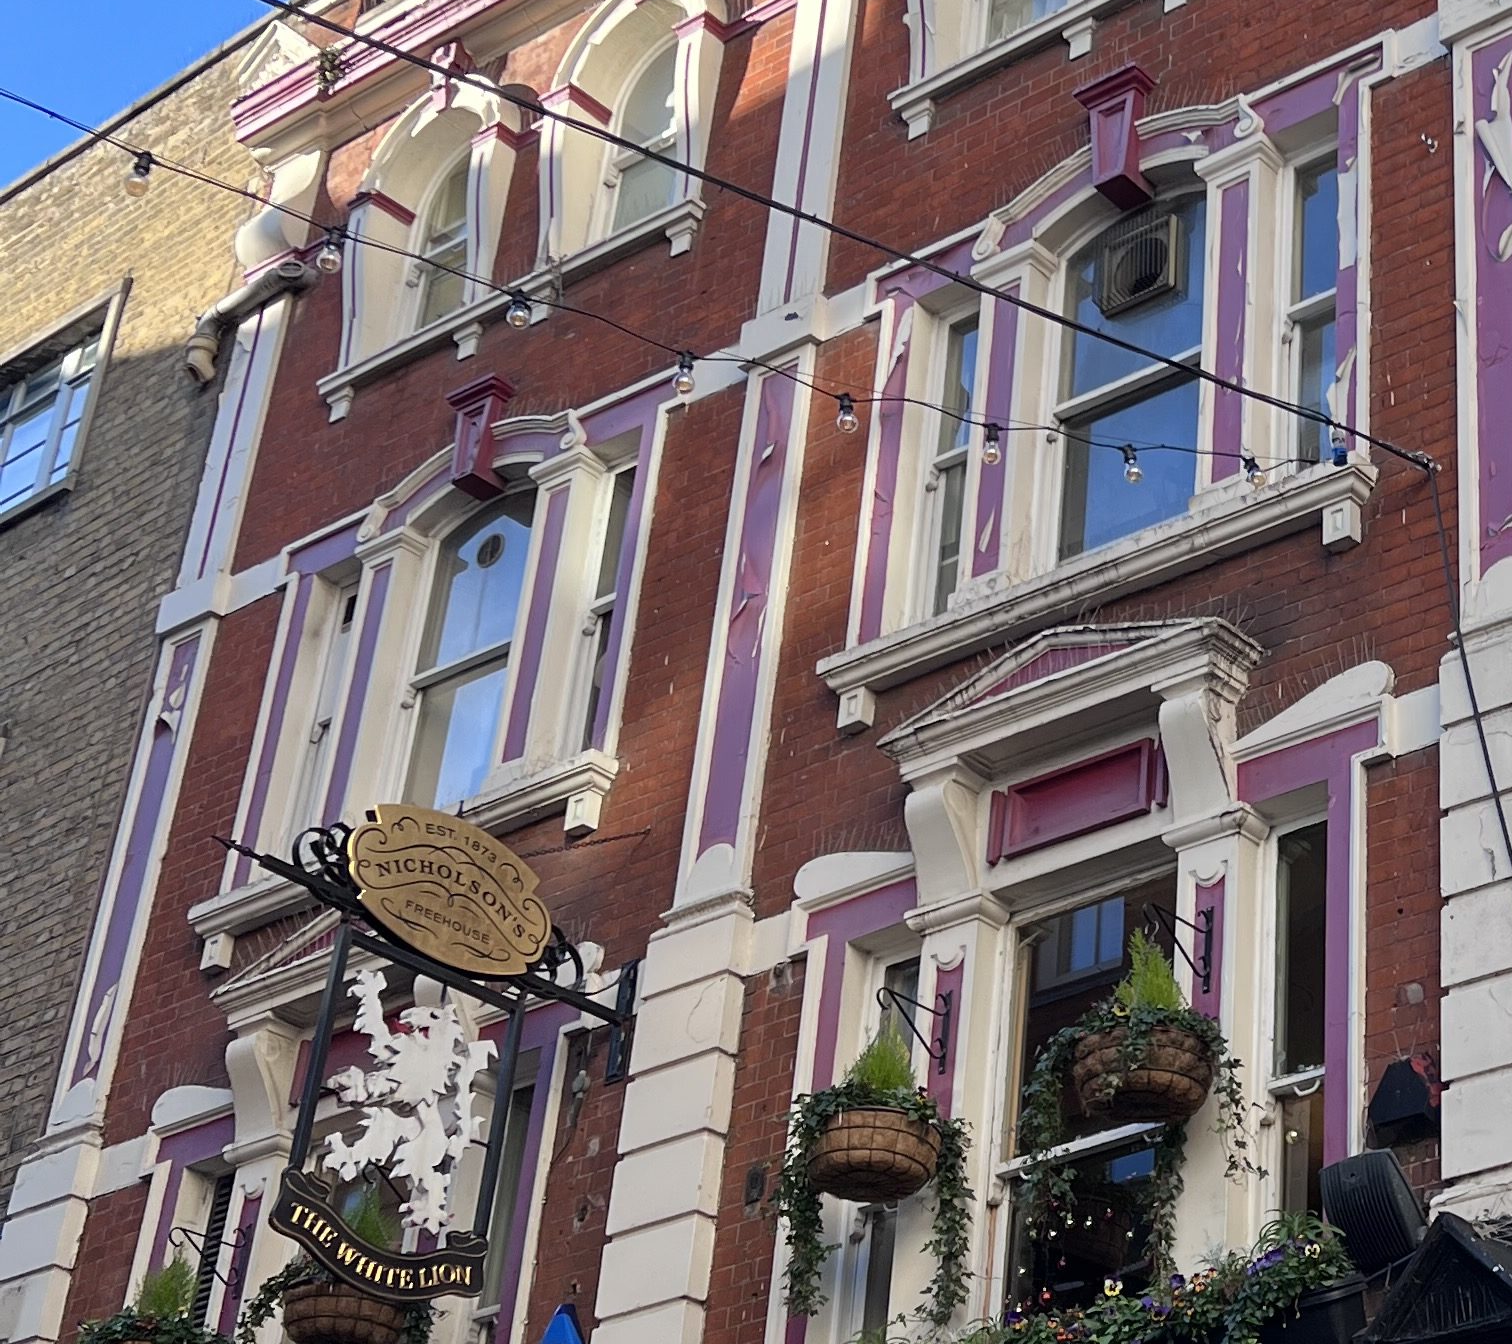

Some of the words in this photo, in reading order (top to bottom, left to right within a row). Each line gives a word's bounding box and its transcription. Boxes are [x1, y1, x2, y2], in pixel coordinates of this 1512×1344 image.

[463, 835, 498, 865] 1873
[375, 857, 527, 940] NICHOLSON'S
[405, 899, 492, 946] FREEHOUSE
[290, 1201, 339, 1249] THE
[336, 1239, 415, 1290] WHITE
[418, 1263, 473, 1289] LION
